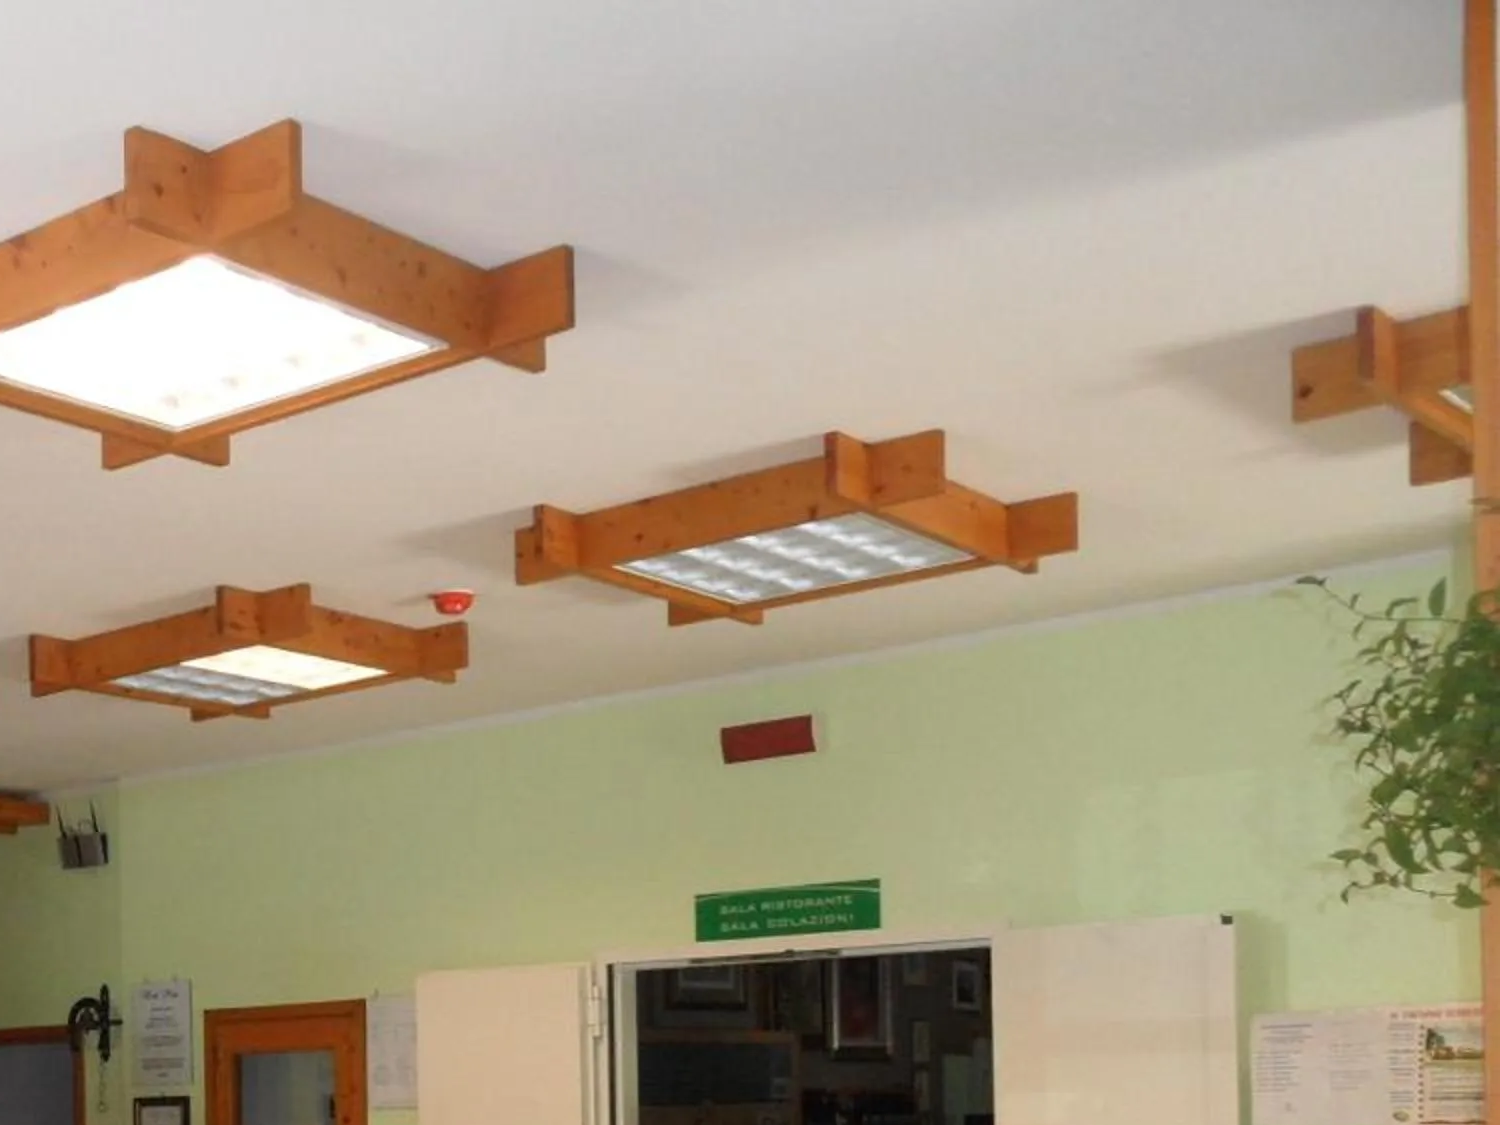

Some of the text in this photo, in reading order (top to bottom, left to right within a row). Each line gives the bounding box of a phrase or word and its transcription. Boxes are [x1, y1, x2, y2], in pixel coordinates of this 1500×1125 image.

[719, 895, 853, 915] SALA RISTORANTE
[720, 920, 759, 933] SALA
